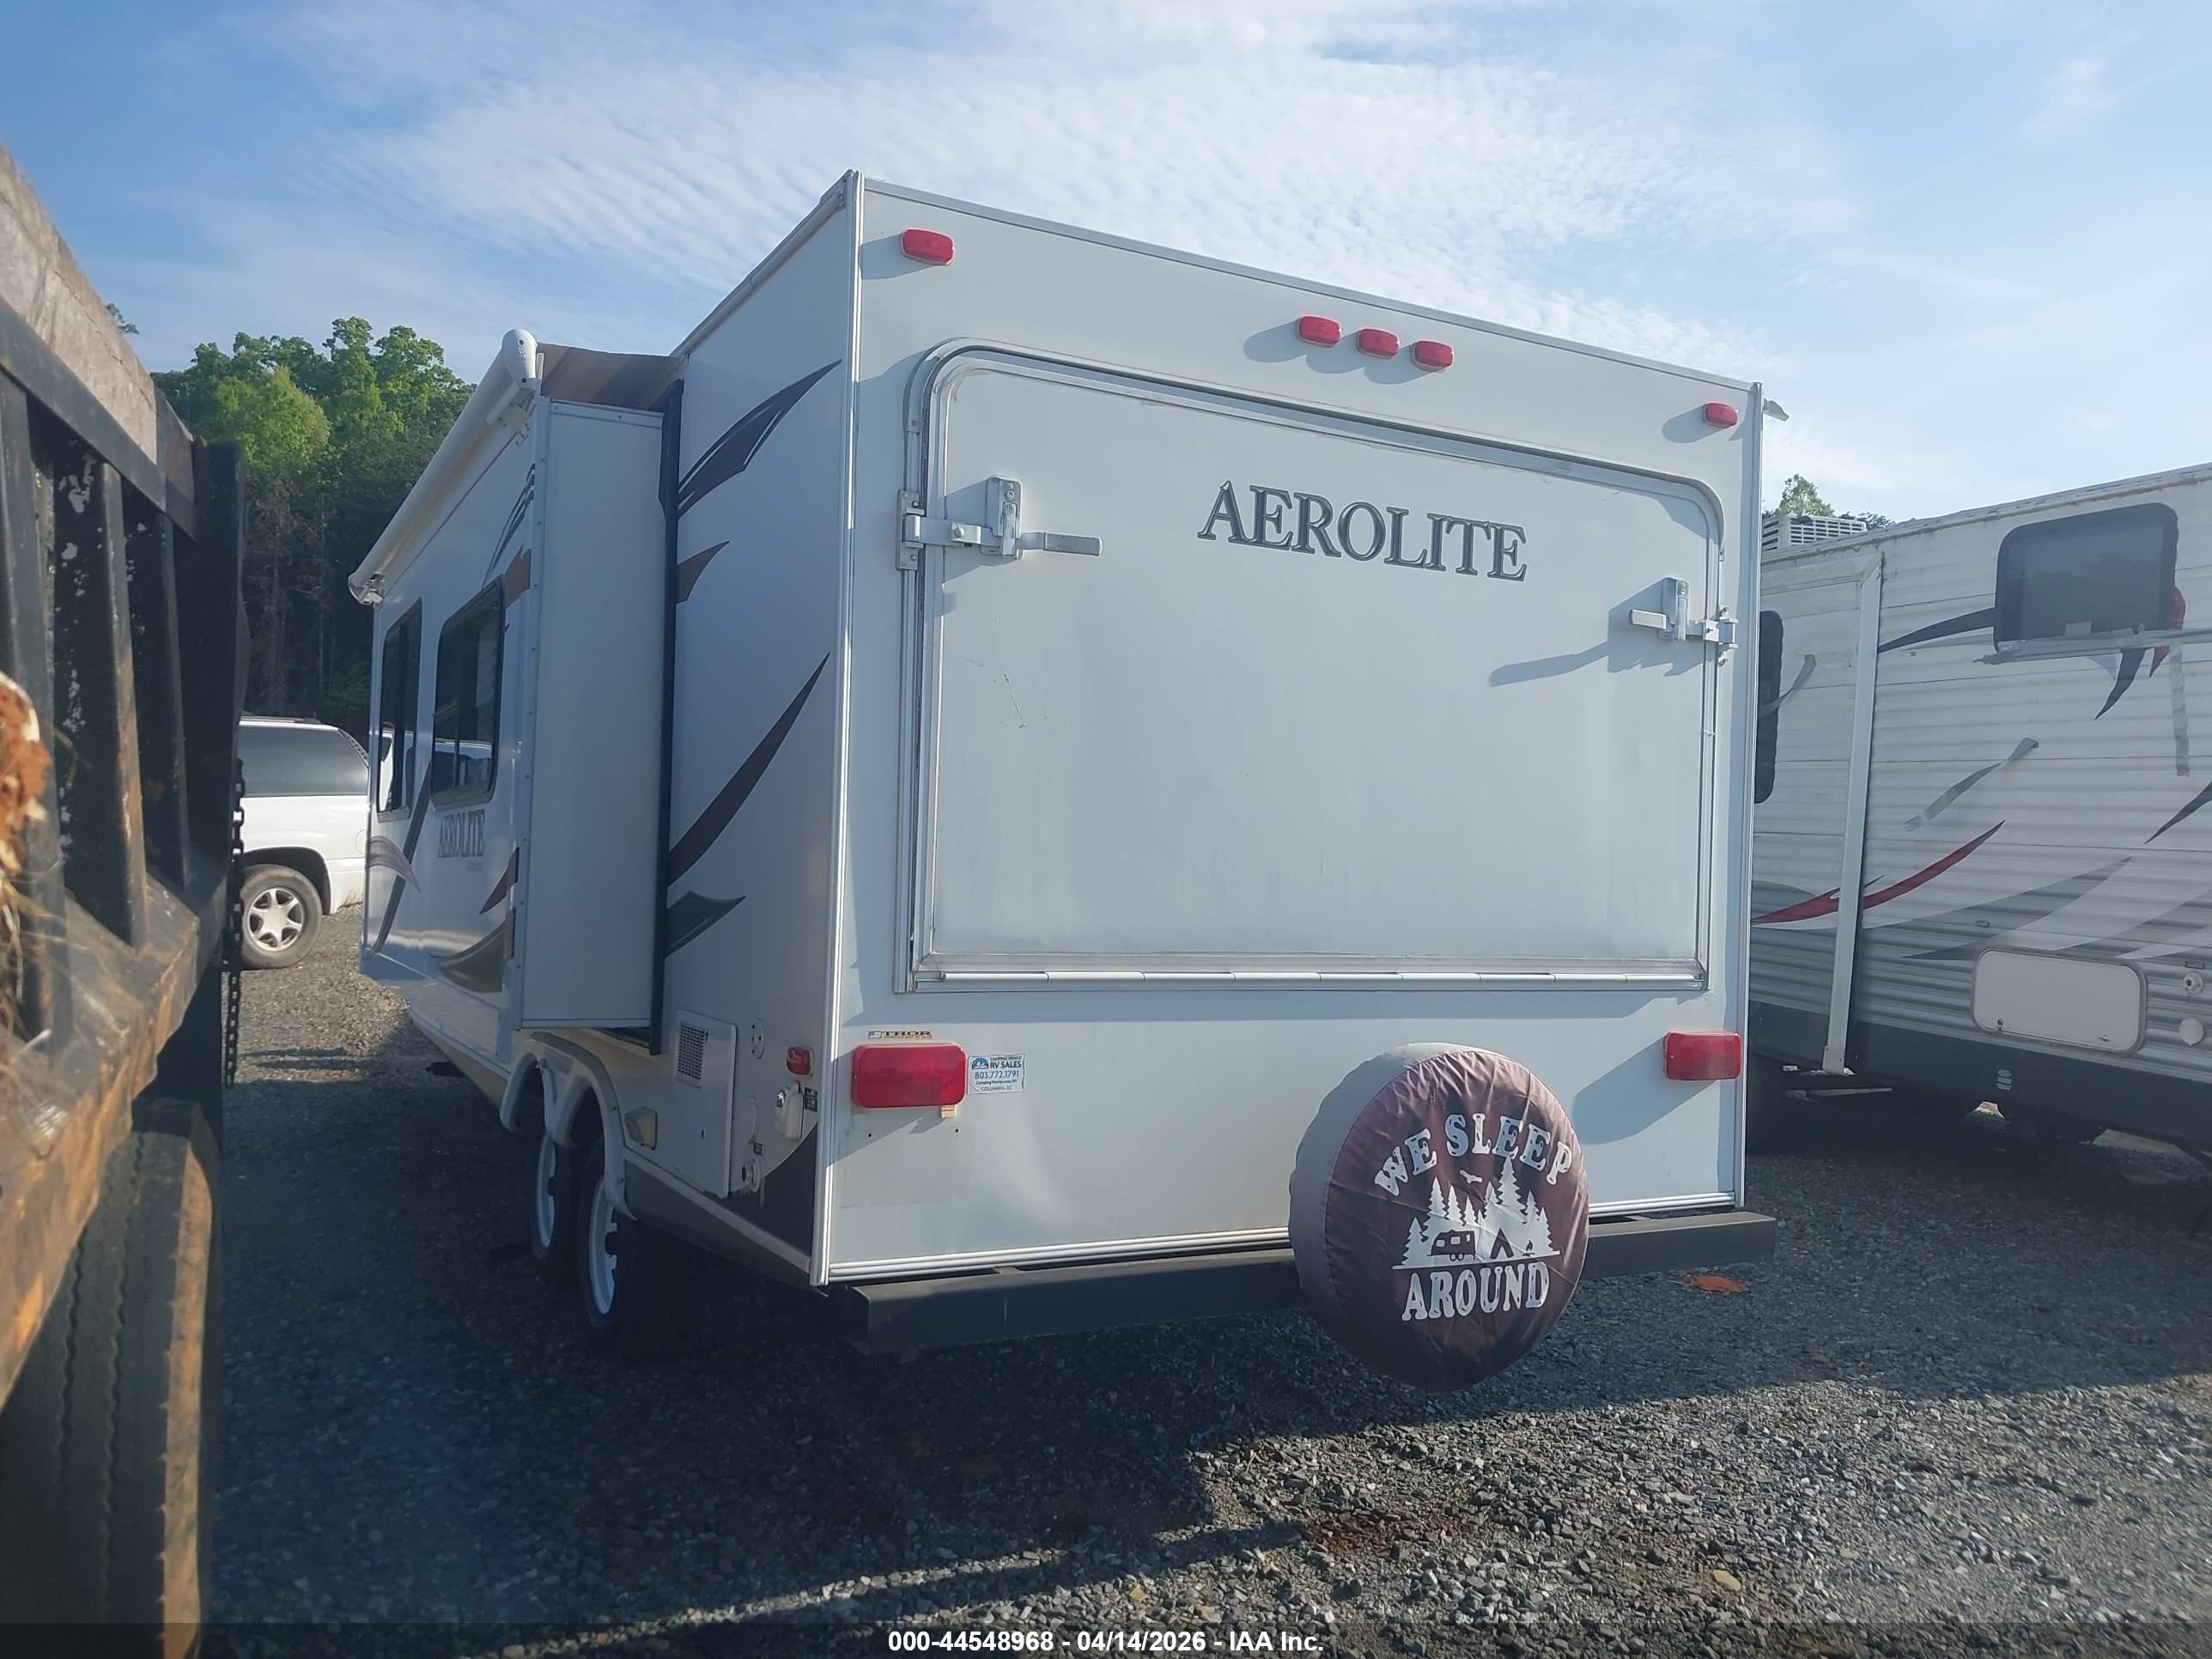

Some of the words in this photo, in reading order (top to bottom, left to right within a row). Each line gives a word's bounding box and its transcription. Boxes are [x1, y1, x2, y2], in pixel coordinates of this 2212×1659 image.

[1197, 480, 1527, 582] AEROLITE
[437, 809, 486, 858] AEROLITE
[975, 1070, 1019, 1079] 803.772.1791
[1374, 1128, 1437, 1196] WE
[1444, 1113, 1572, 1185] SLEEP
[1401, 1261, 1550, 1322] AROUND
